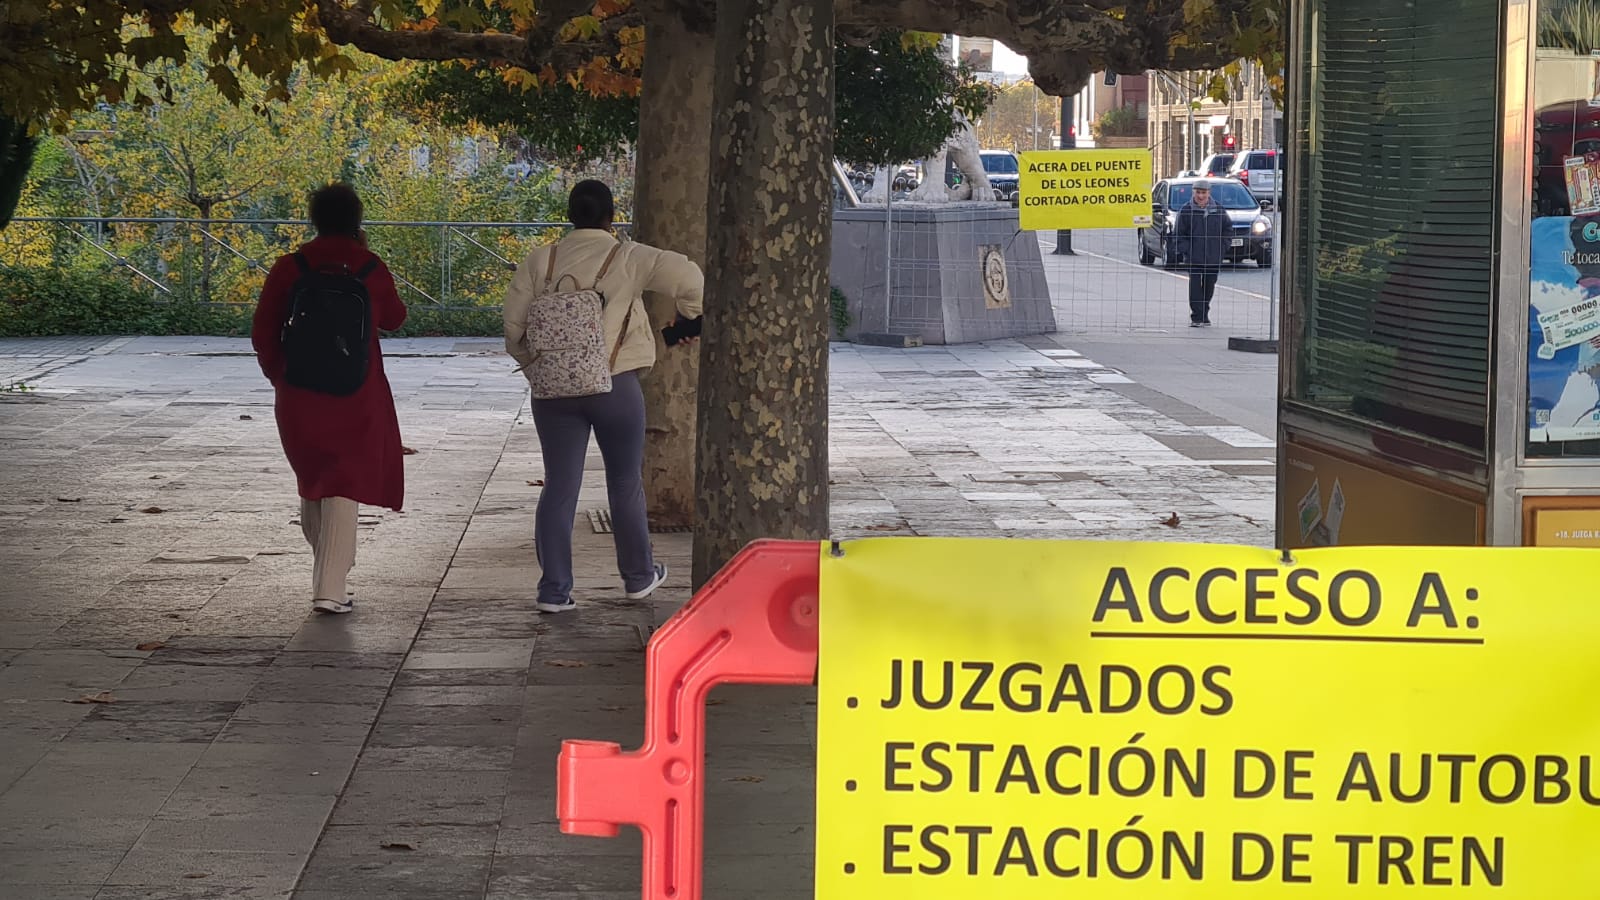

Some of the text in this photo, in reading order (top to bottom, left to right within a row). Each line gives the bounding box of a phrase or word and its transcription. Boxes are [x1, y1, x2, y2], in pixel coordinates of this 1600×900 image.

[1028, 160, 1141, 173] ACERA DEL PUENTE
[1041, 177, 1130, 190] DE LOS LEONES
[1024, 193, 1147, 206] CORTADA POR OBRAS
[1561, 250, 1575, 265] Te
[1571, 530, 1593, 539] JUEGA
[1092, 566, 1479, 629] ACCESO A:
[881, 659, 1233, 716] JUZGADOS
[884, 732, 1206, 798] ESTACIÓN
[1233, 749, 1314, 800] DE
[883, 815, 1204, 880] ESTACIÓN
[1232, 832, 1313, 883] DE
[1335, 835, 1504, 887] TREN
